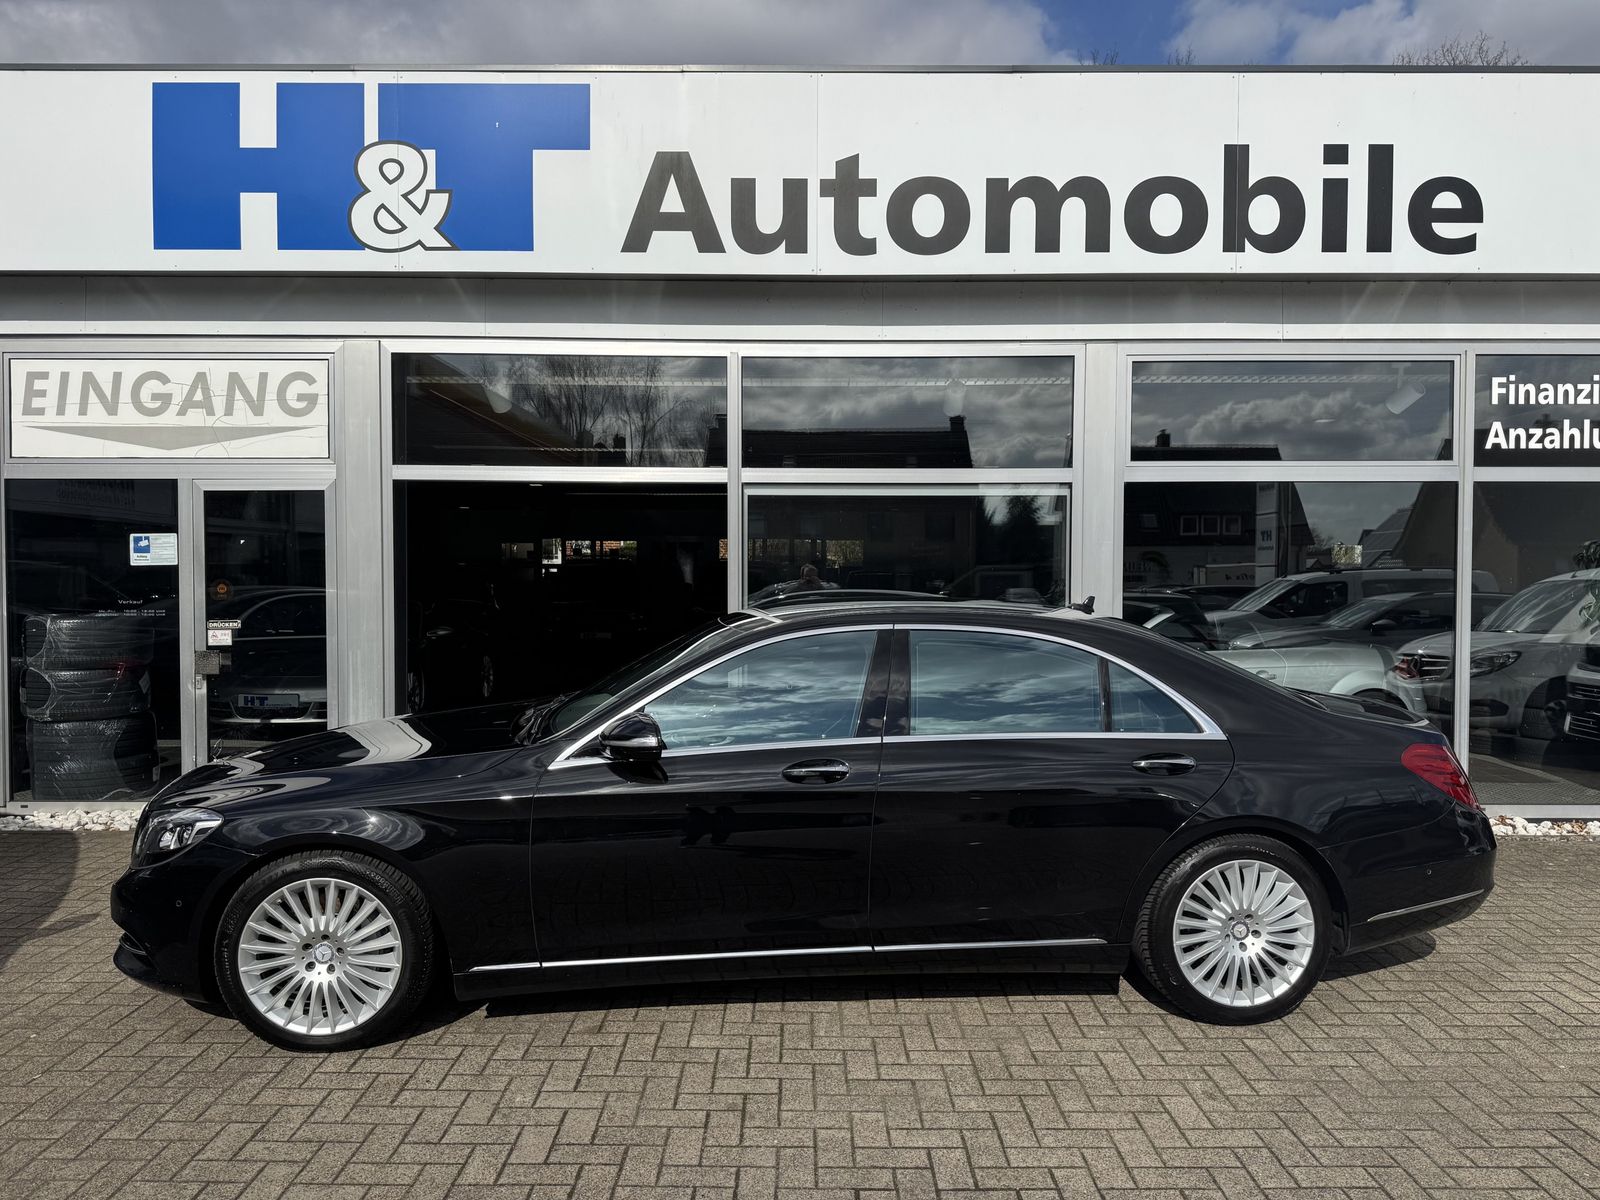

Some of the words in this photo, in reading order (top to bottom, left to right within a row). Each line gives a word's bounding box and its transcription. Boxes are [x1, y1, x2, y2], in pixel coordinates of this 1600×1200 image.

[152, 83, 591, 253] H&T
[621, 143, 1484, 256] Automobile
[22, 371, 319, 417] EINGANG
[1491, 375, 1600, 405] Finanzi
